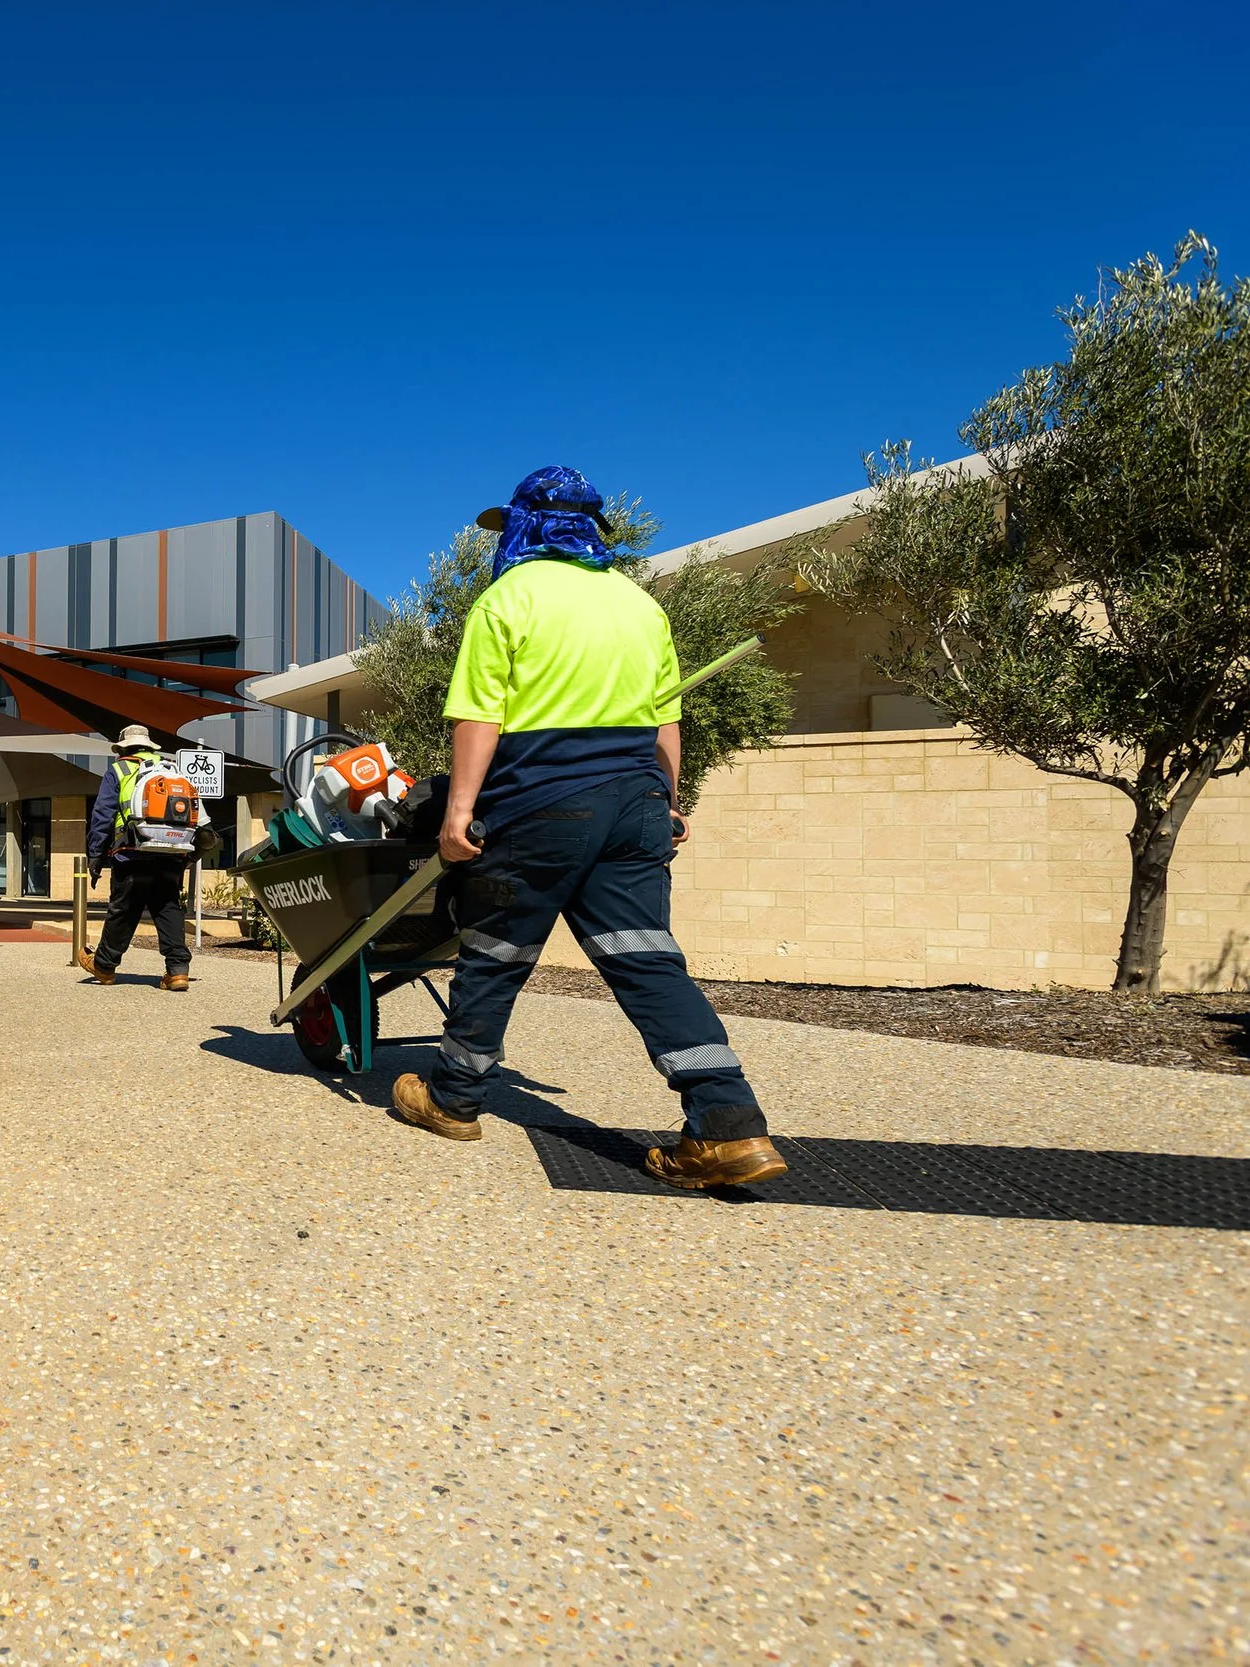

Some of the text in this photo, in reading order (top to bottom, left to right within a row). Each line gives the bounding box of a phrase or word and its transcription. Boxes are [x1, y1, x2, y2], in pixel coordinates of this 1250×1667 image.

[185, 775, 218, 785] YCLISTS
[194, 785, 219, 794] MOUNT
[408, 858, 431, 870] SHE
[263, 874, 332, 909] SHERLOCK
